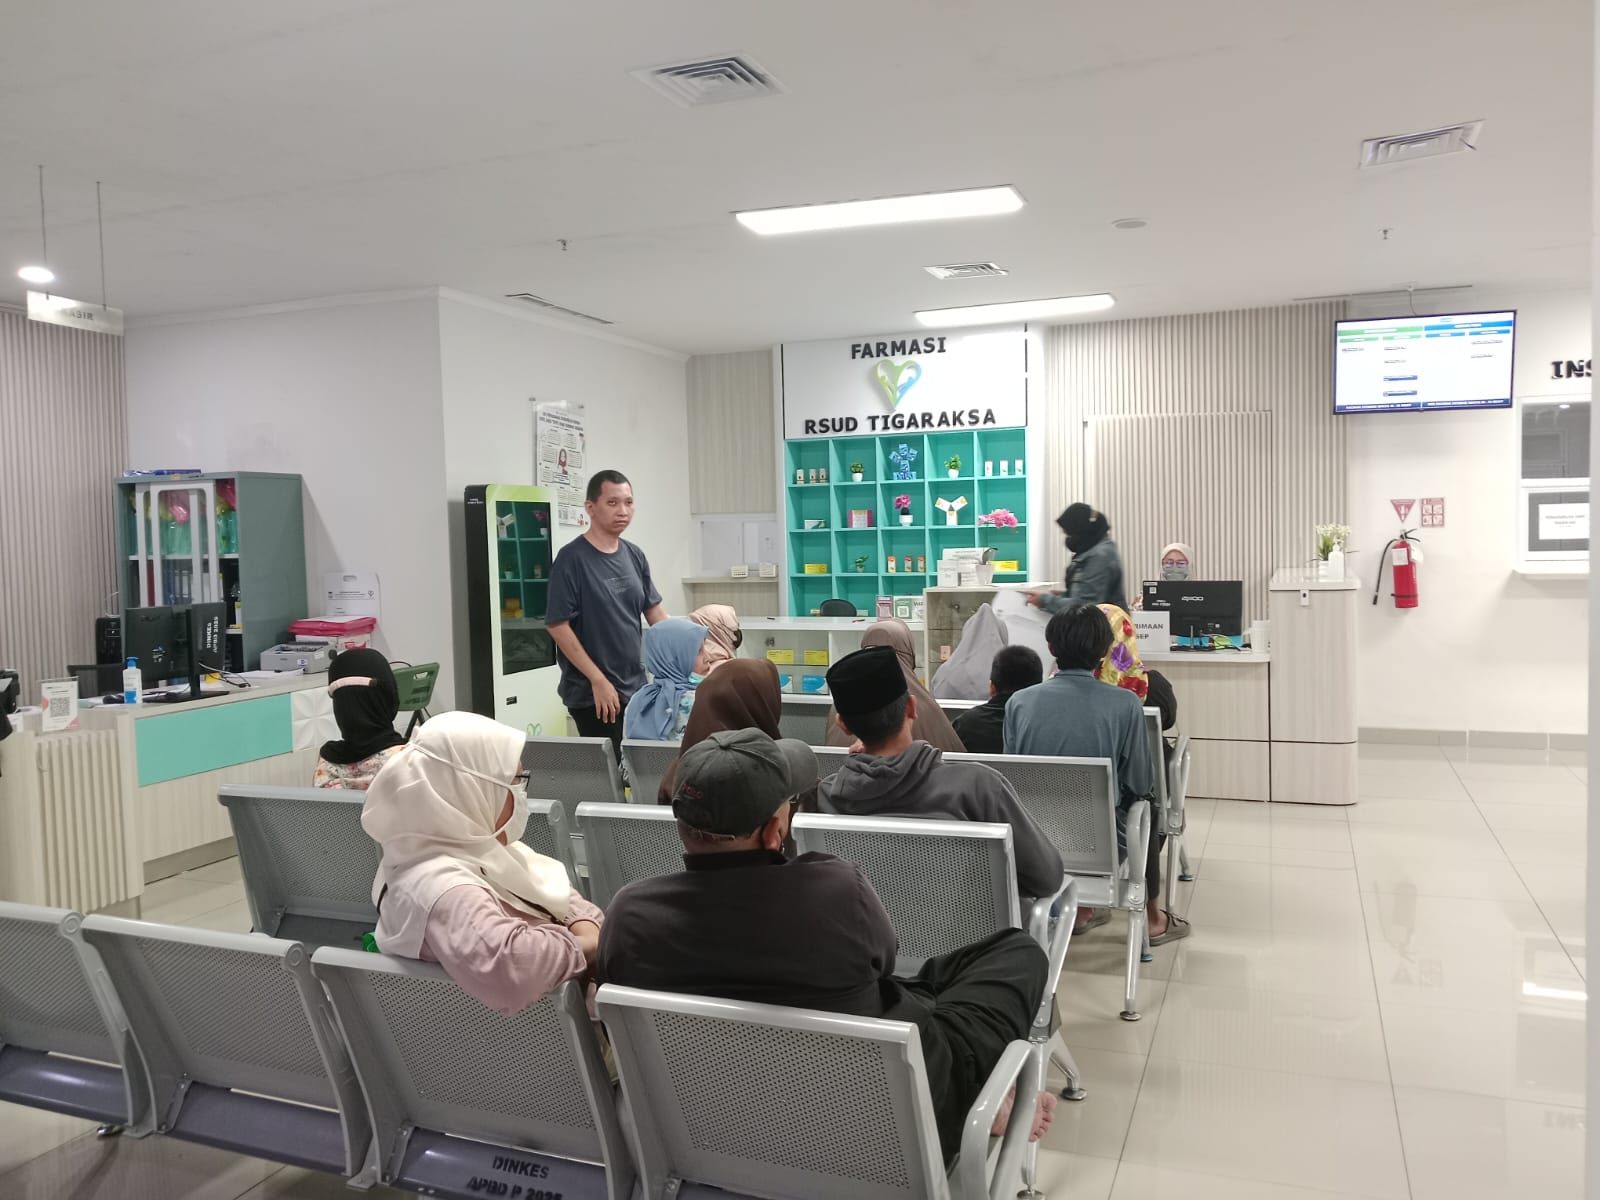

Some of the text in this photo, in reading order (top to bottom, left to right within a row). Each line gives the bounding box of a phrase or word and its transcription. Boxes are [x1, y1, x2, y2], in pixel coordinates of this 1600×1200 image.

[850, 337, 947, 359] FARMASI
[804, 409, 997, 434] RSUD TIGARAKSA
[491, 1155, 550, 1179] DINKES
[466, 1176, 509, 1197] APBD
[510, 1184, 523, 1199] P
